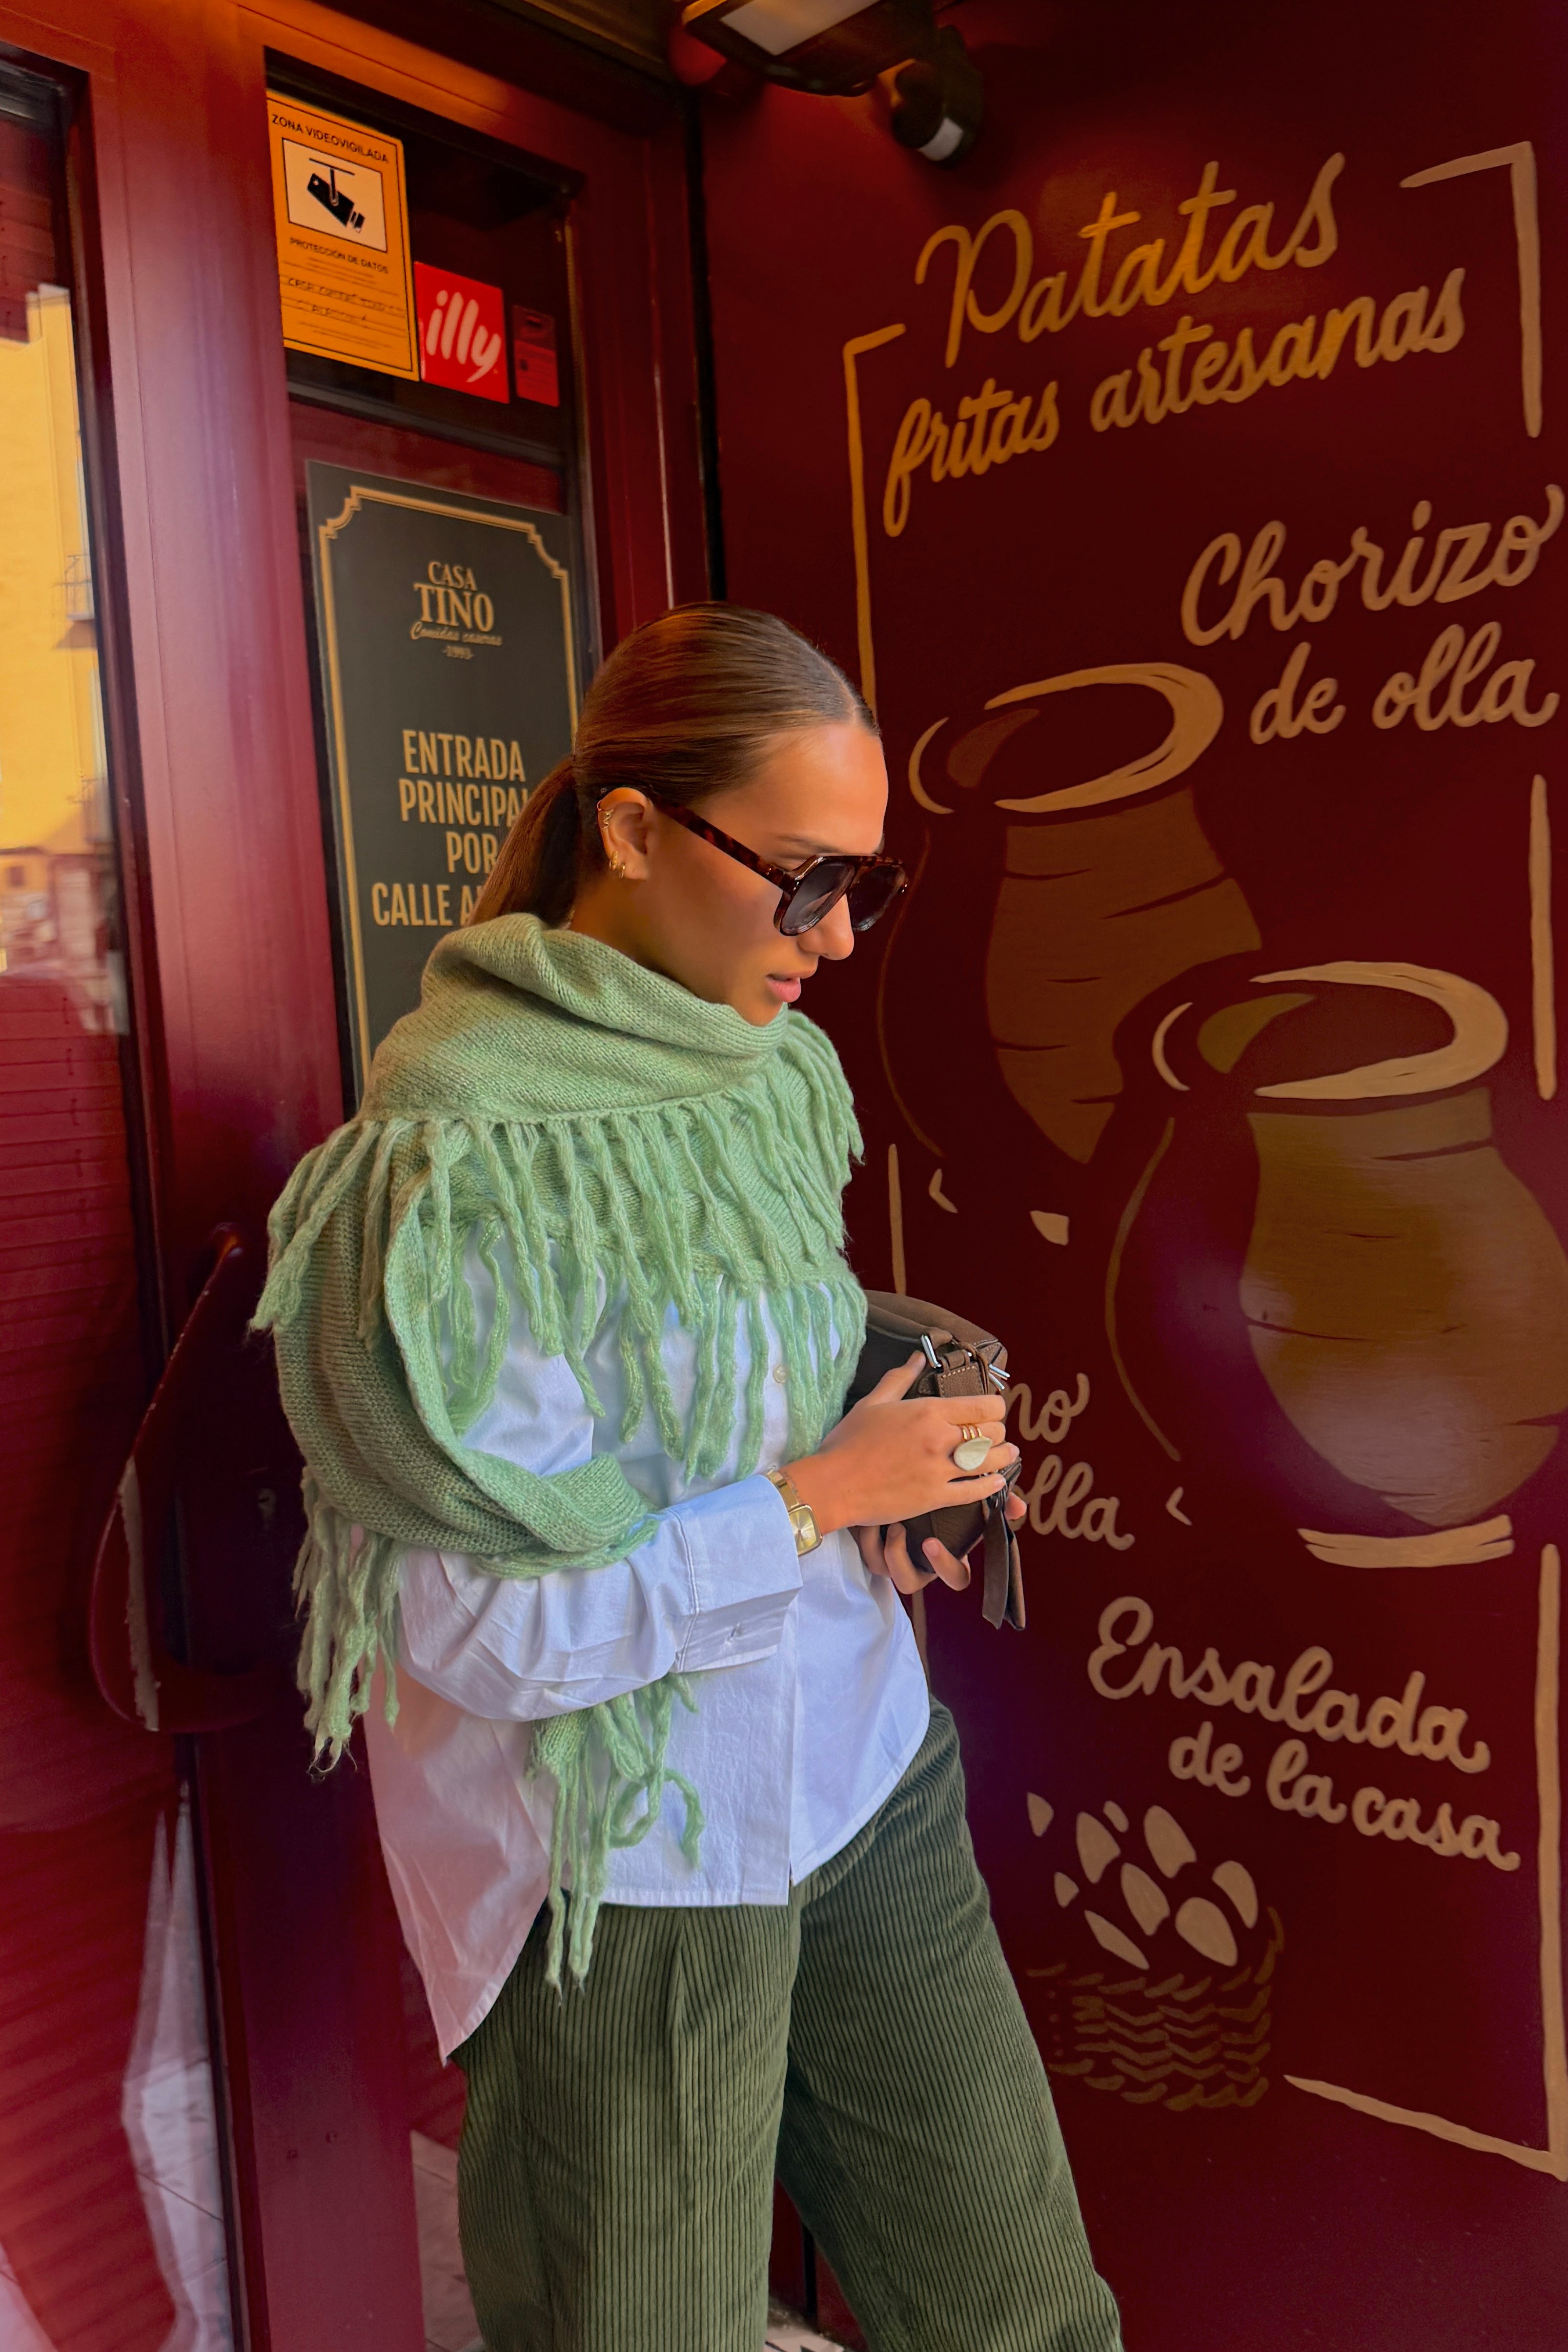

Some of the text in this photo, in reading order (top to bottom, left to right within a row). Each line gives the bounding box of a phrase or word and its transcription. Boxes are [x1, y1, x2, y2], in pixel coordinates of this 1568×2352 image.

[272, 114, 303, 133] ZONA
[914, 151, 1345, 368] Patatas
[426, 289, 502, 383] illy
[883, 267, 1466, 537] fritas artesanas
[413, 583, 494, 633] TINO
[428, 560, 477, 591] CASA
[1181, 483, 1565, 647] Chorizo
[1249, 621, 1560, 745] de olla
[402, 729, 526, 782] ENTRADA
[371, 882, 452, 927] CALLE
[1087, 1596, 1491, 1773] Ensalada
[1168, 1720, 1521, 1872] de la casa
